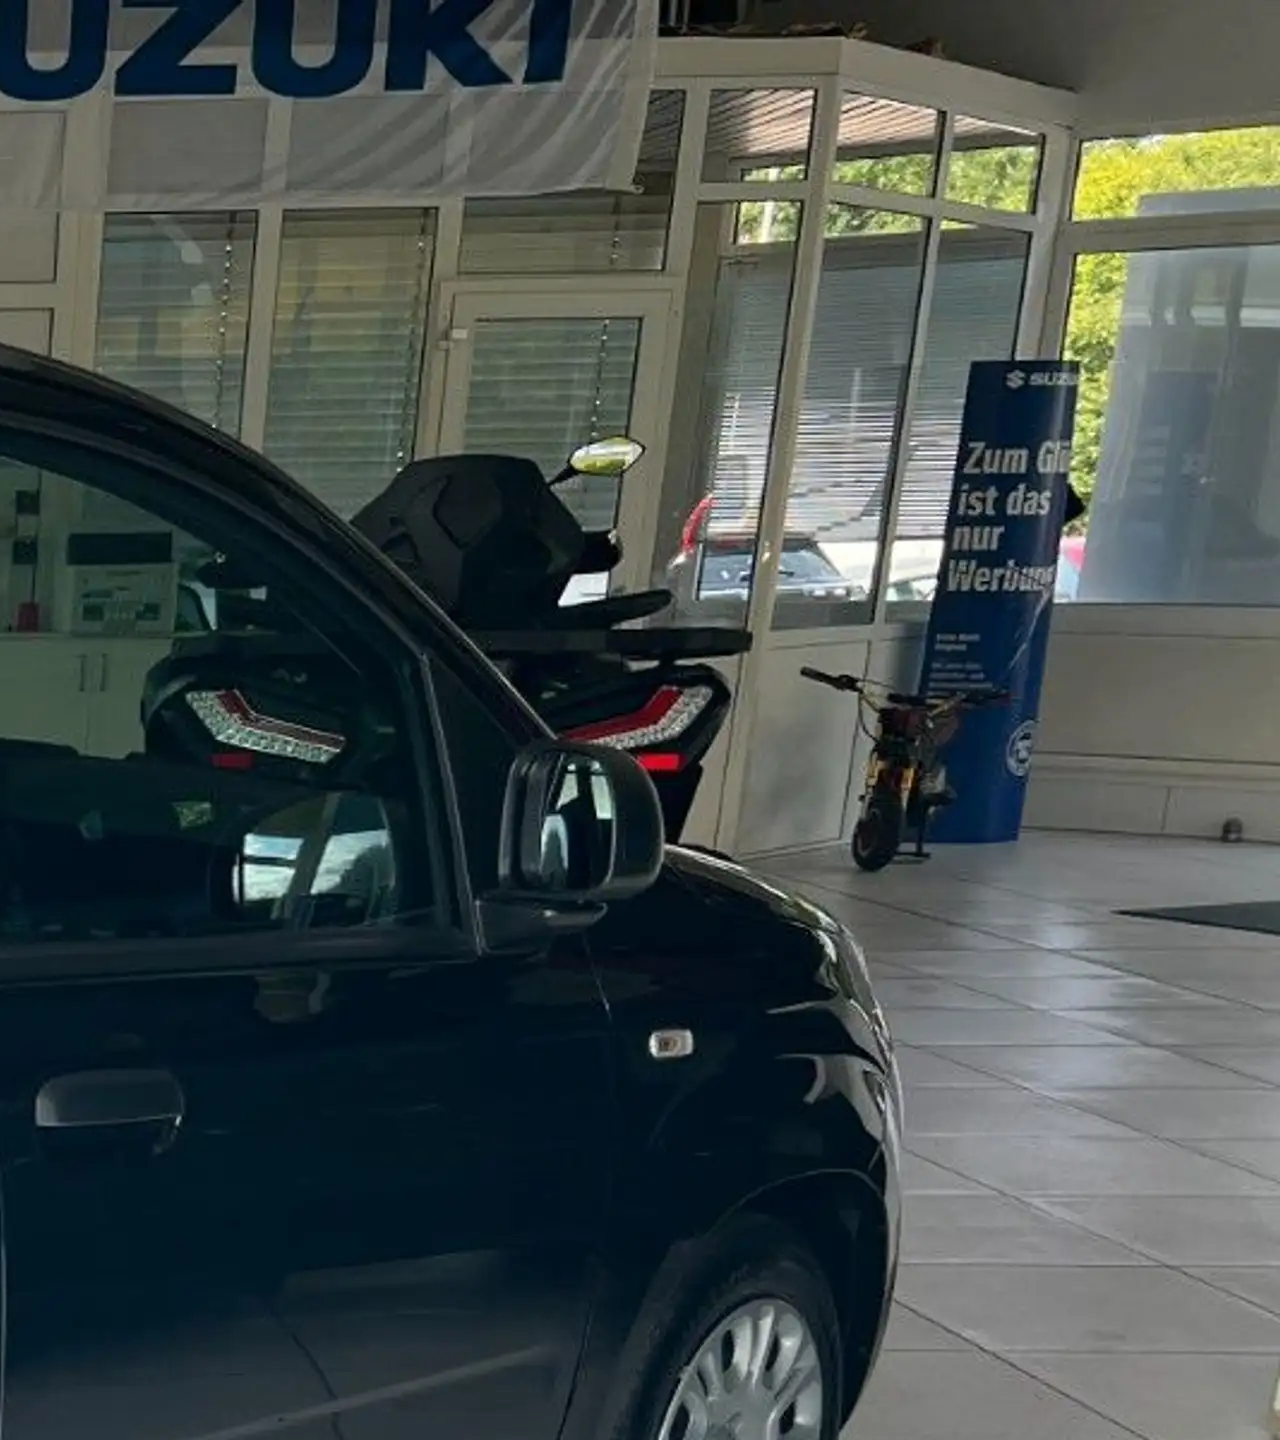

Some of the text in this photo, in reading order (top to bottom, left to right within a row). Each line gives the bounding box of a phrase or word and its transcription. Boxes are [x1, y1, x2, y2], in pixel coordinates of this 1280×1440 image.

[962, 441, 1027, 474] Zum
[957, 483, 1052, 516] ist das
[951, 525, 1005, 551] nur
